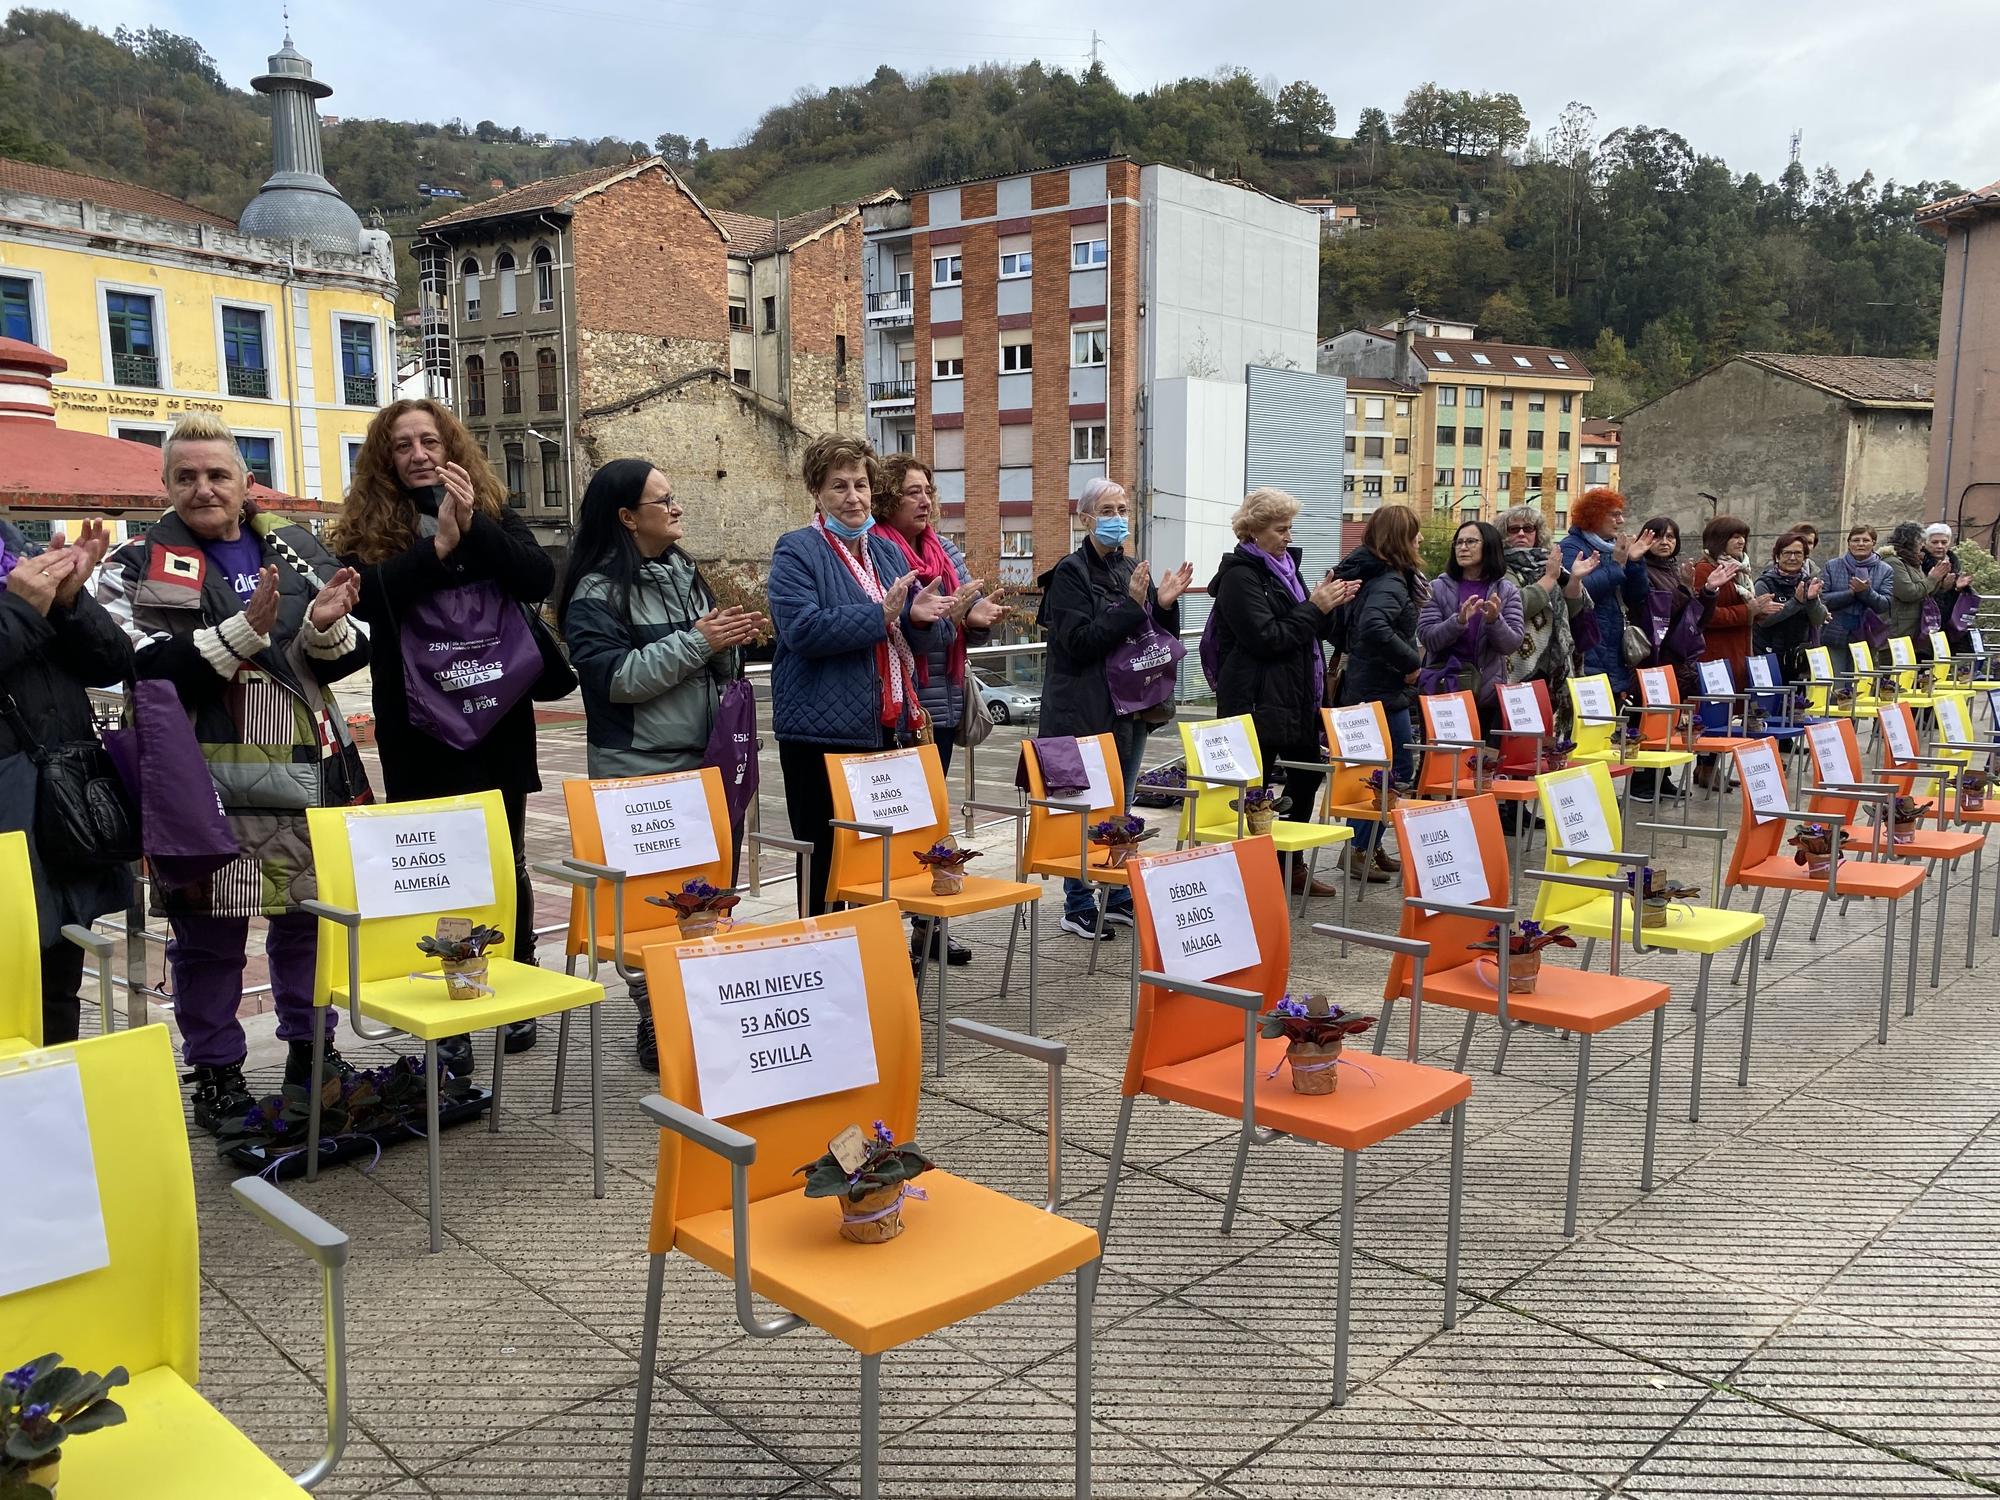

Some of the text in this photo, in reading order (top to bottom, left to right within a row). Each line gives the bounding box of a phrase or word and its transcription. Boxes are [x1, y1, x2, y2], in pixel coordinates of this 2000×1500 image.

[50, 387, 223, 413] Servicio Municipal de Empleo
[428, 641, 450, 652] 25N
[1129, 645, 1171, 664] QUEREMOS
[1143, 642, 1160, 656] NOS
[433, 660, 503, 681] QUEREMOS
[451, 659, 479, 670] NOS
[1141, 656, 1166, 669] VIVAS
[449, 671, 491, 689] VIVAS
[475, 697, 499, 711] PSOE
[870, 773, 892, 784] SARA
[869, 788, 902, 802] 38 AÑOS
[624, 799, 673, 815] CLOTILDE
[872, 803, 910, 819] NAVARRA
[1568, 811, 1583, 824] AÑOS
[630, 818, 676, 834] 82 AÑOS
[395, 831, 437, 845] MAITE
[1429, 829, 1450, 843] LUISA
[633, 837, 681, 854] TENERIFE
[391, 852, 447, 868] 50 AÑOS
[1434, 850, 1454, 864] AÑOS
[393, 873, 451, 891] ALMERÍA
[1431, 871, 1461, 888] ALICANTE
[1169, 881, 1207, 900] DÉBORA
[1175, 906, 1214, 927] 39 AÑOS
[1181, 932, 1222, 955] MÁLAGA
[718, 970, 824, 1001] MARI NIEVES
[740, 1007, 810, 1034] 53 AÑOS
[749, 1042, 813, 1070] SEVILLA
